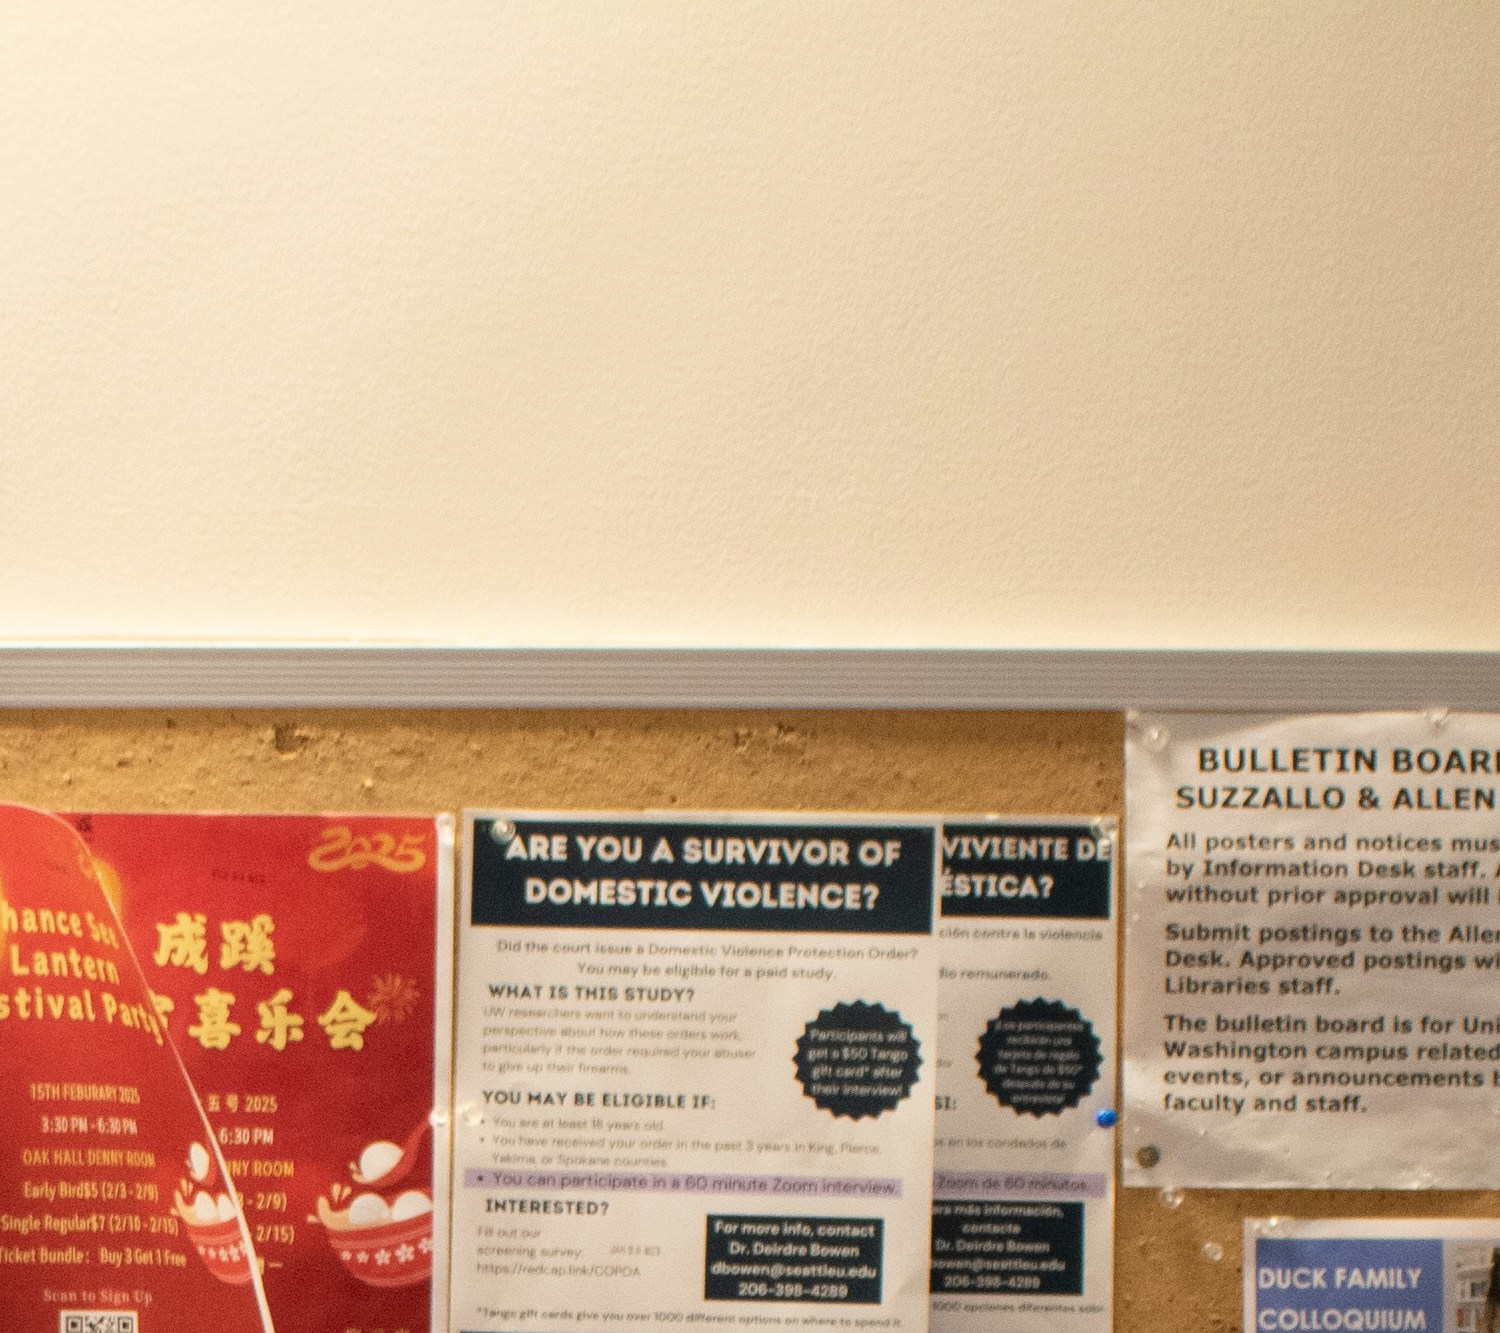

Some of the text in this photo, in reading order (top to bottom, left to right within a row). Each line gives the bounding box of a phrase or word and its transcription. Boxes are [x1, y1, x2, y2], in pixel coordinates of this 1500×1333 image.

[1199, 748, 1379, 774] BULLETIN
[1176, 787, 1346, 810] SUZZALLO
[1359, 790, 1381, 810] &
[1393, 788, 1497, 811] ALLEN
[308, 826, 426, 874] 2025
[504, 836, 901, 867] ARE YOU A SURVIVOR OF
[1166, 833, 1197, 851] All
[1206, 834, 1295, 854] posters
[1304, 833, 1347, 852] and
[1356, 834, 1442, 853] notices
[526, 879, 879, 910] DOMESTIC VIOLENCE?
[11, 945, 120, 984] Lantern
[1164, 976, 1340, 996] Libraries staff.
[1163, 1093, 1368, 1115] faculty and staff.
[485, 1198, 609, 1216] INTERESTED?
